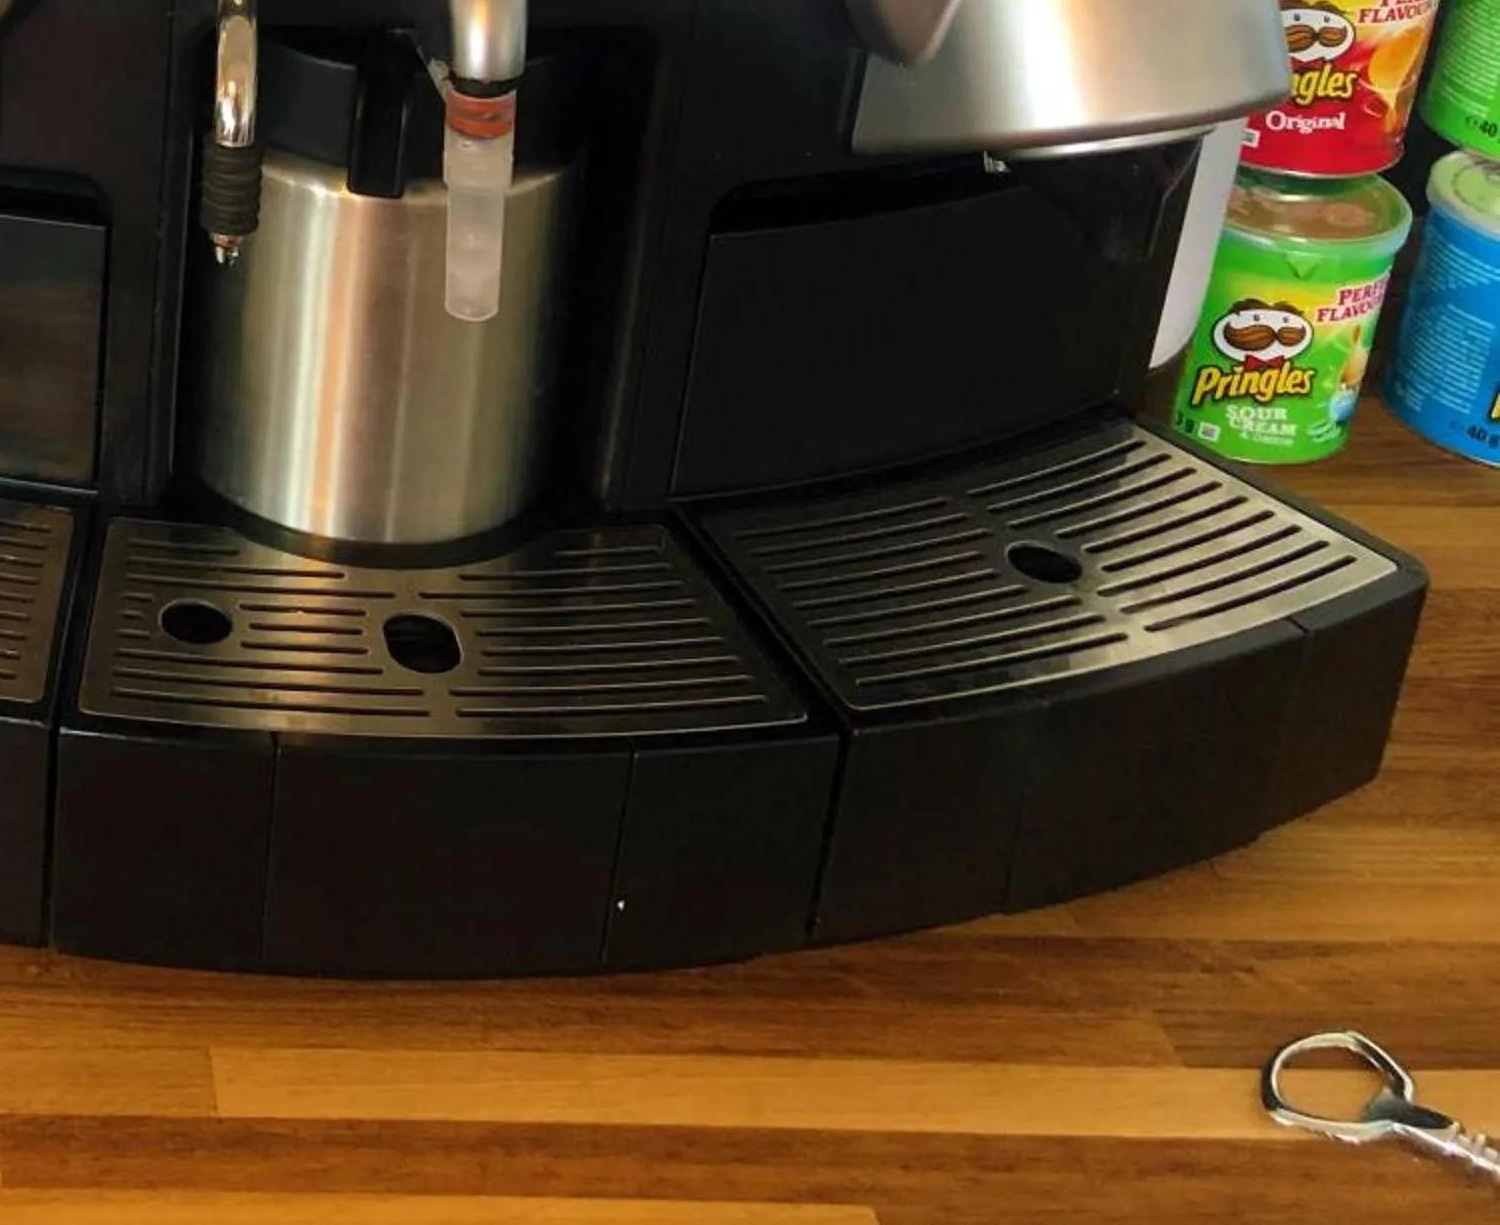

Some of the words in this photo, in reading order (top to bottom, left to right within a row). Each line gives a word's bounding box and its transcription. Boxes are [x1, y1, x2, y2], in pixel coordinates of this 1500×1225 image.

[1291, 62, 1358, 106] ngles
[1265, 110, 1346, 134] Original
[1191, 360, 1316, 407] Pringles
